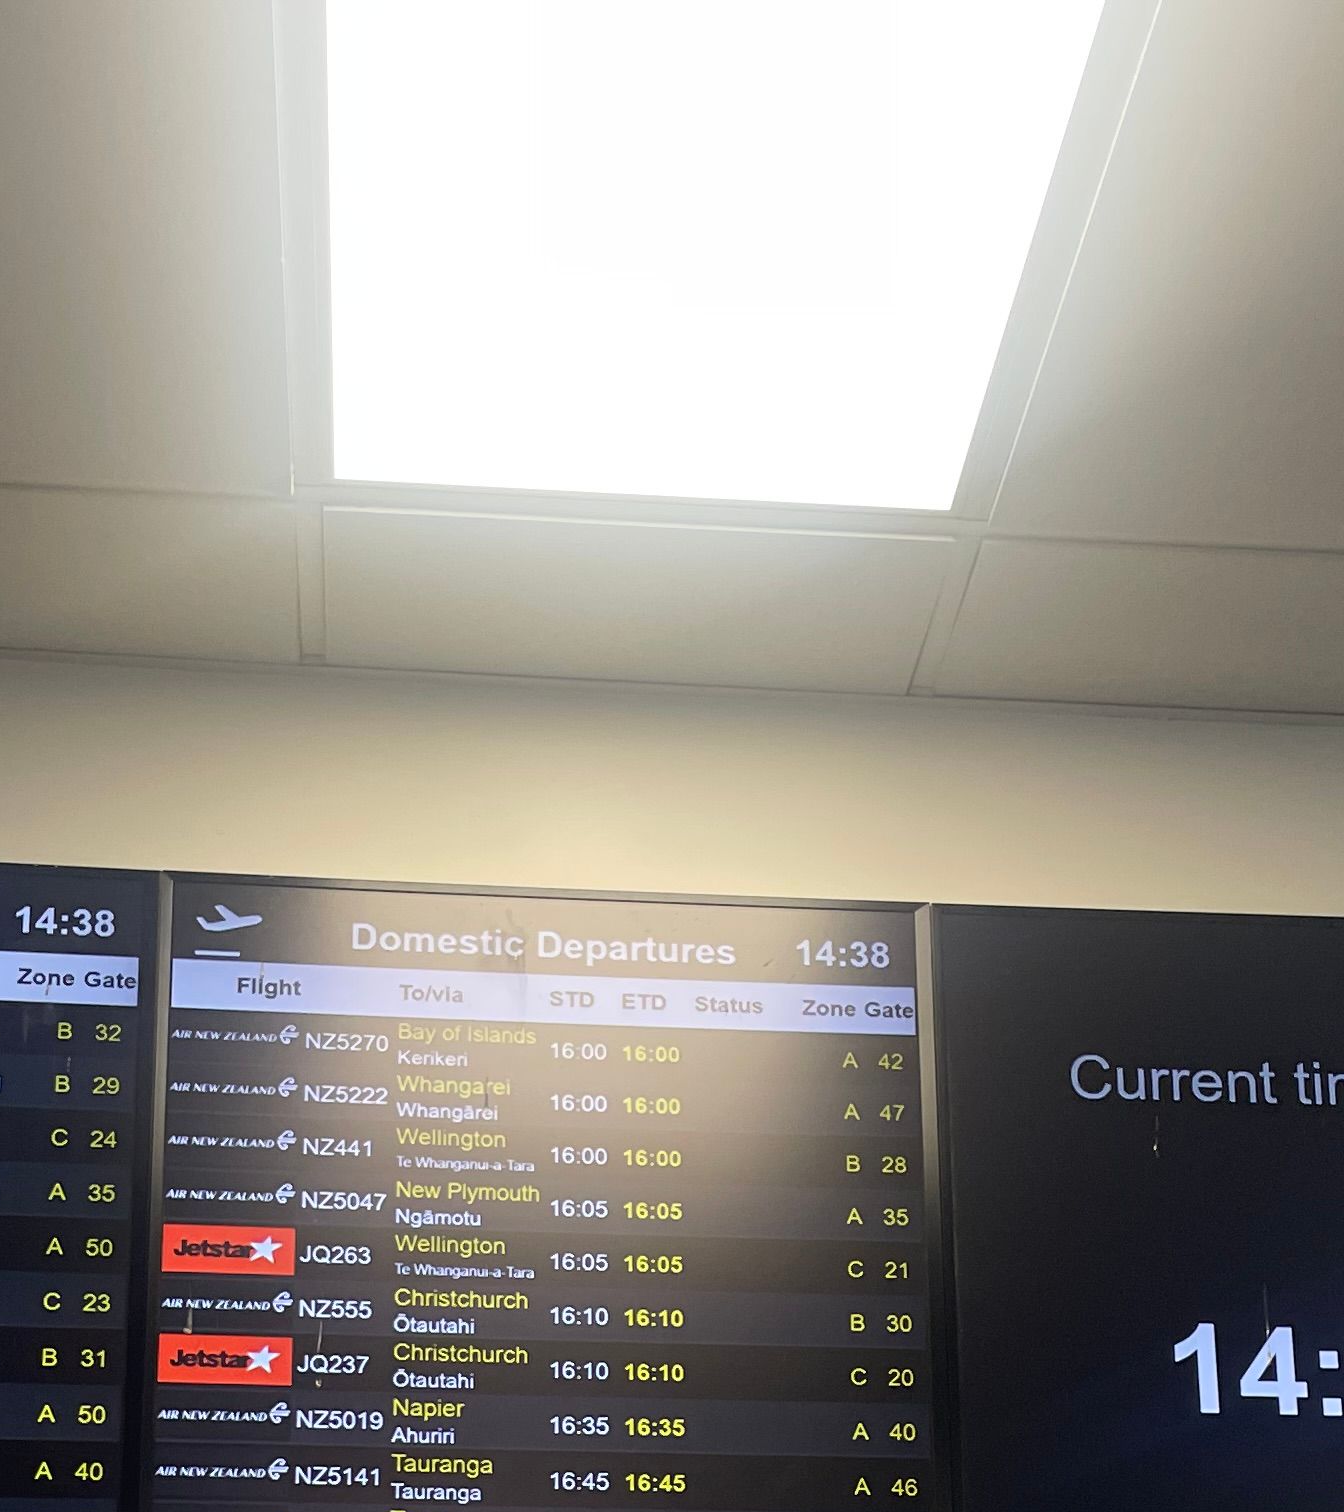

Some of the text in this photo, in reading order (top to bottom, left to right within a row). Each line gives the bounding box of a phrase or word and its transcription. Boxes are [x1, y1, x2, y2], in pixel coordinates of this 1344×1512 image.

[16, 906, 114, 936] 14:38
[353, 924, 735, 966] Domestic Departures
[793, 935, 889, 972] 14:38
[17, 968, 74, 986] Zone
[85, 972, 136, 989] Gate
[238, 976, 913, 1018] Flight To/via STD ETD Status Zone Gate
[58, 1022, 72, 1039] B
[96, 1024, 121, 1041] 32
[171, 1023, 902, 1069] AIR NEW ZEALAND NZ5270 Bay of Islands 16:00 16:00 A 42
[1071, 1055, 1277, 1103] Current
[51, 1129, 68, 1146] C
[90, 1130, 117, 1148] 24
[46, 1237, 63, 1255] A
[86, 1239, 113, 1256] 50
[173, 1234, 907, 1278] Jetstar JQ263 Wellington 16:05 16:05 C 21
[395, 1263, 410, 1274] Te
